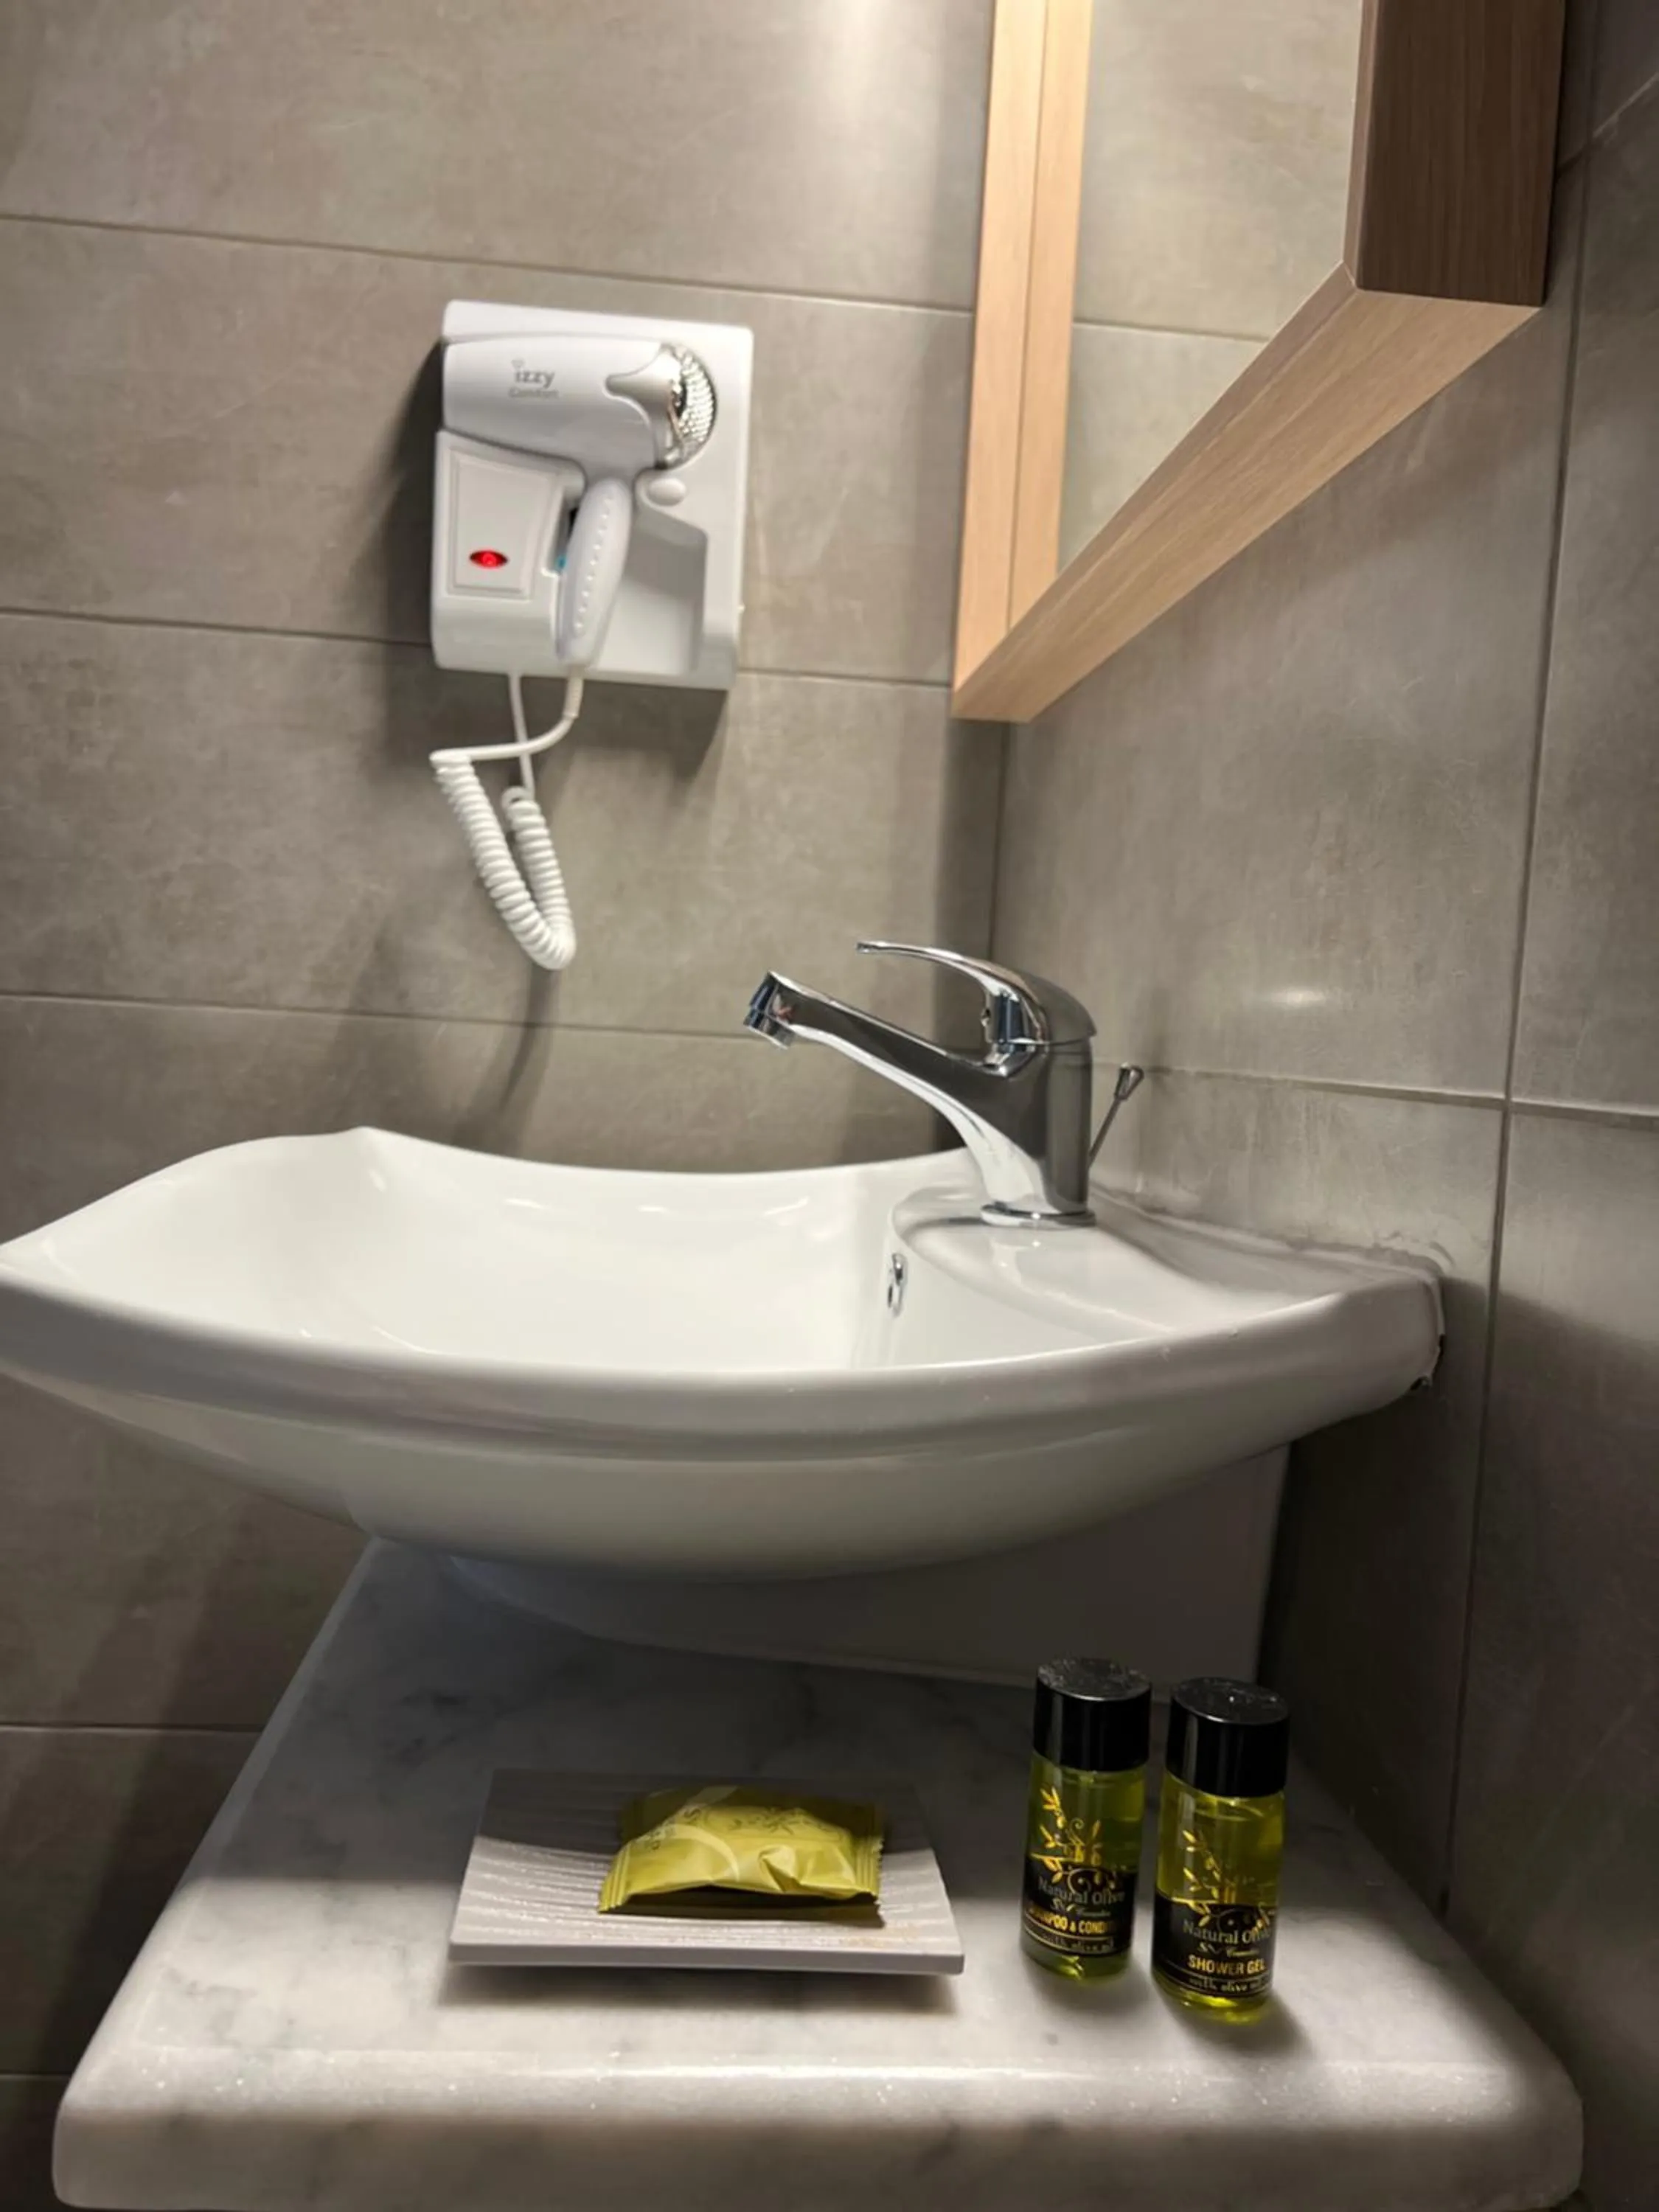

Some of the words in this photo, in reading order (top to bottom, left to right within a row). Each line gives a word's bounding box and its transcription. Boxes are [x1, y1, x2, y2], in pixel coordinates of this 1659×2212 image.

[511, 360, 556, 389] izzy
[1183, 1919, 1239, 1944] Natural
[1188, 1955, 1245, 1975] SHOWER
[1246, 1958, 1266, 1975] GEL
